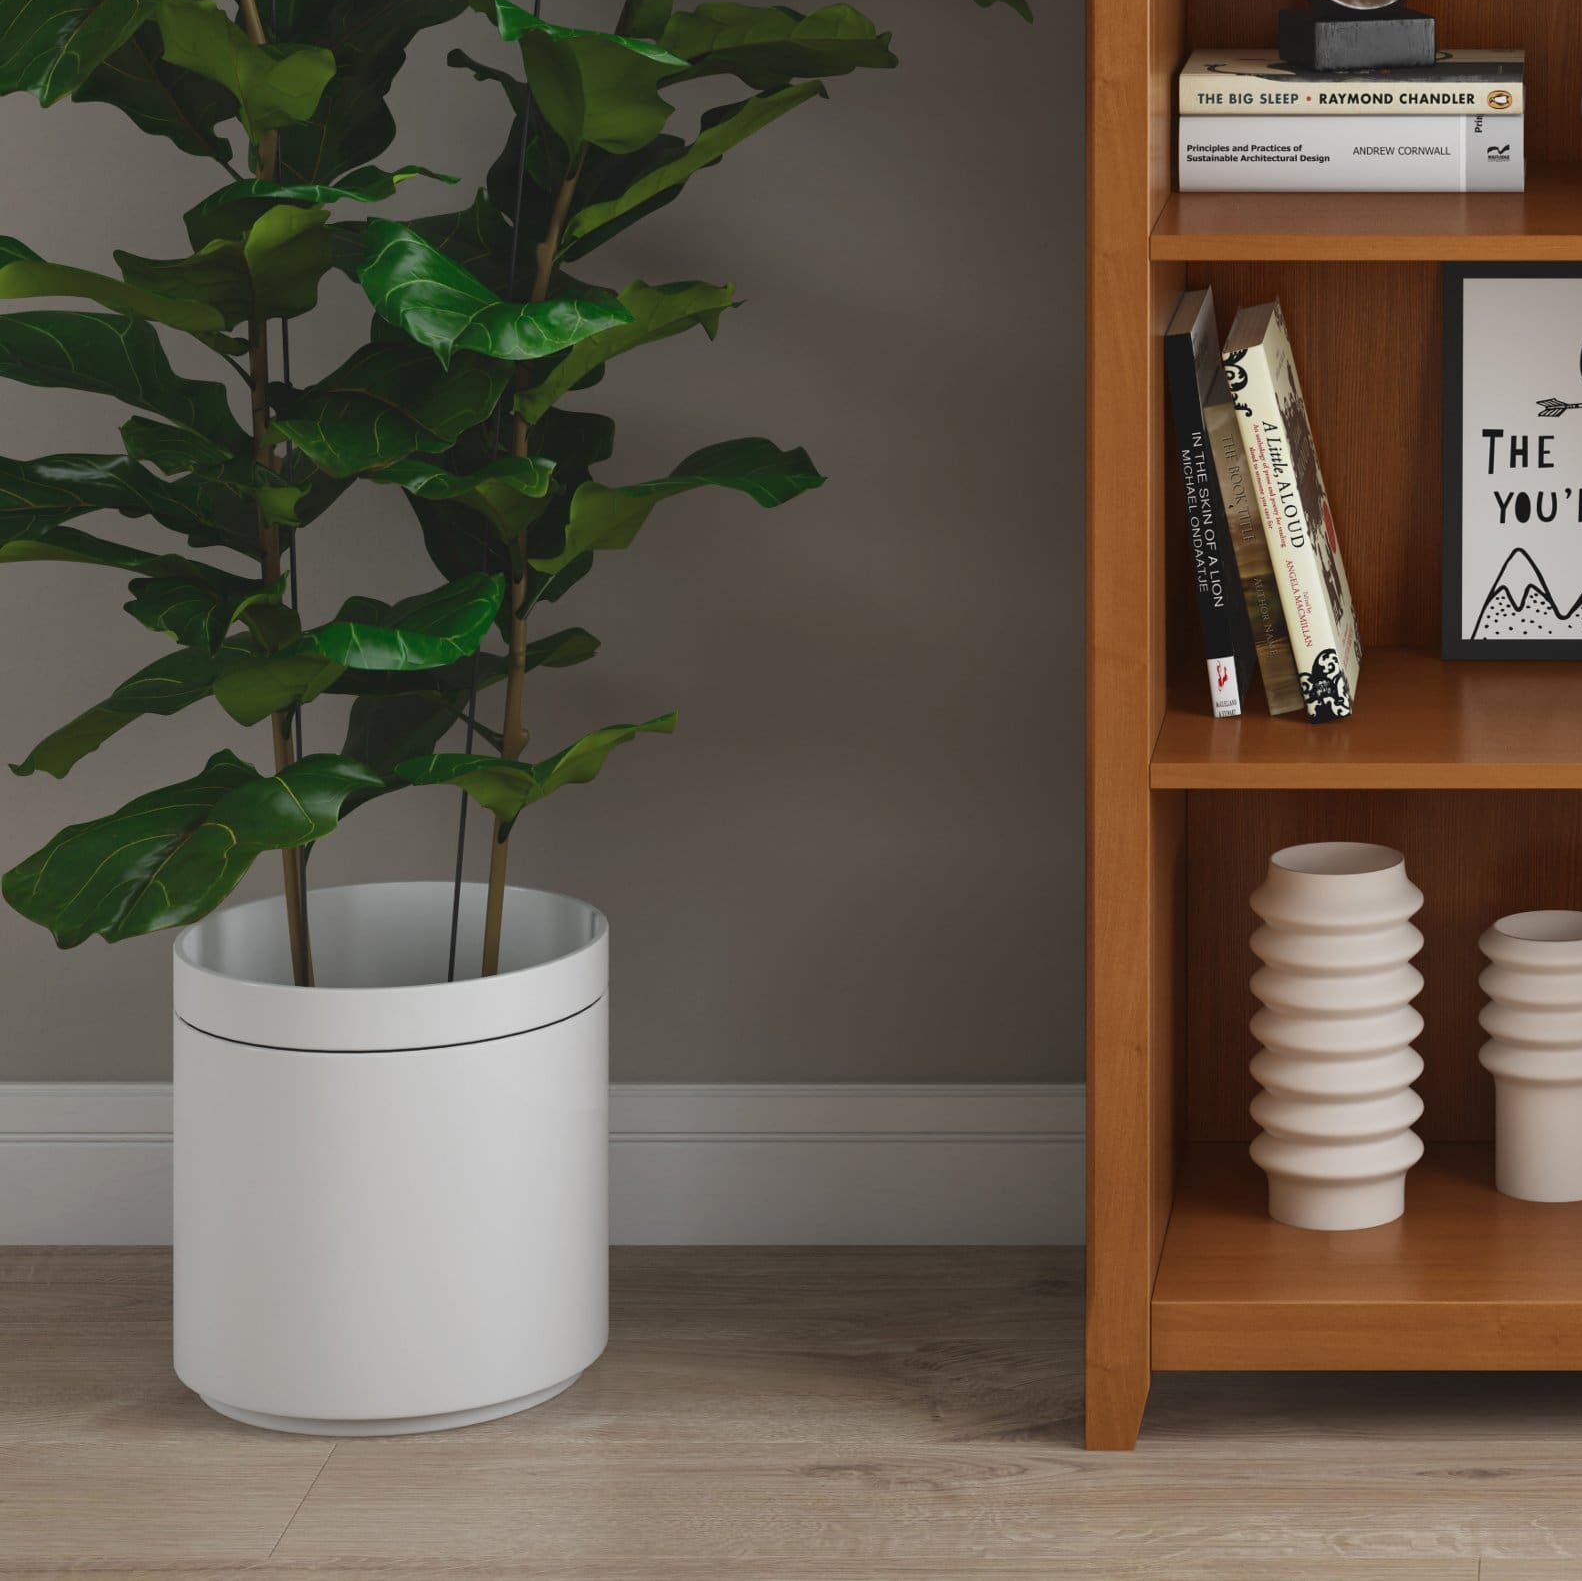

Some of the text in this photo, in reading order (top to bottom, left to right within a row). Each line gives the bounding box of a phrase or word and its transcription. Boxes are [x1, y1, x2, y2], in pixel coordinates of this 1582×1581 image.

[1197, 92, 1475, 105] THE BIG SLEEP RAYMOND CHANDLER
[1186, 144, 1303, 154] Principles and Practices of
[1186, 154, 1330, 164] Sustainable Architectural Design
[1352, 146, 1451, 156] ANDREW CORNWALL
[1222, 433, 1237, 459] THE
[1482, 428, 1555, 475] THE
[1228, 465, 1247, 505] BOOK
[1262, 421, 1305, 549] A Little, ALOUD
[1181, 449, 1209, 593] MICHAEL ONDAATJE
[1191, 431, 1225, 608] IN THE SKIN OF A LION
[1254, 578, 1270, 621] AUTHOR
[1285, 560, 1313, 648] ANGELA MACMILLAN
